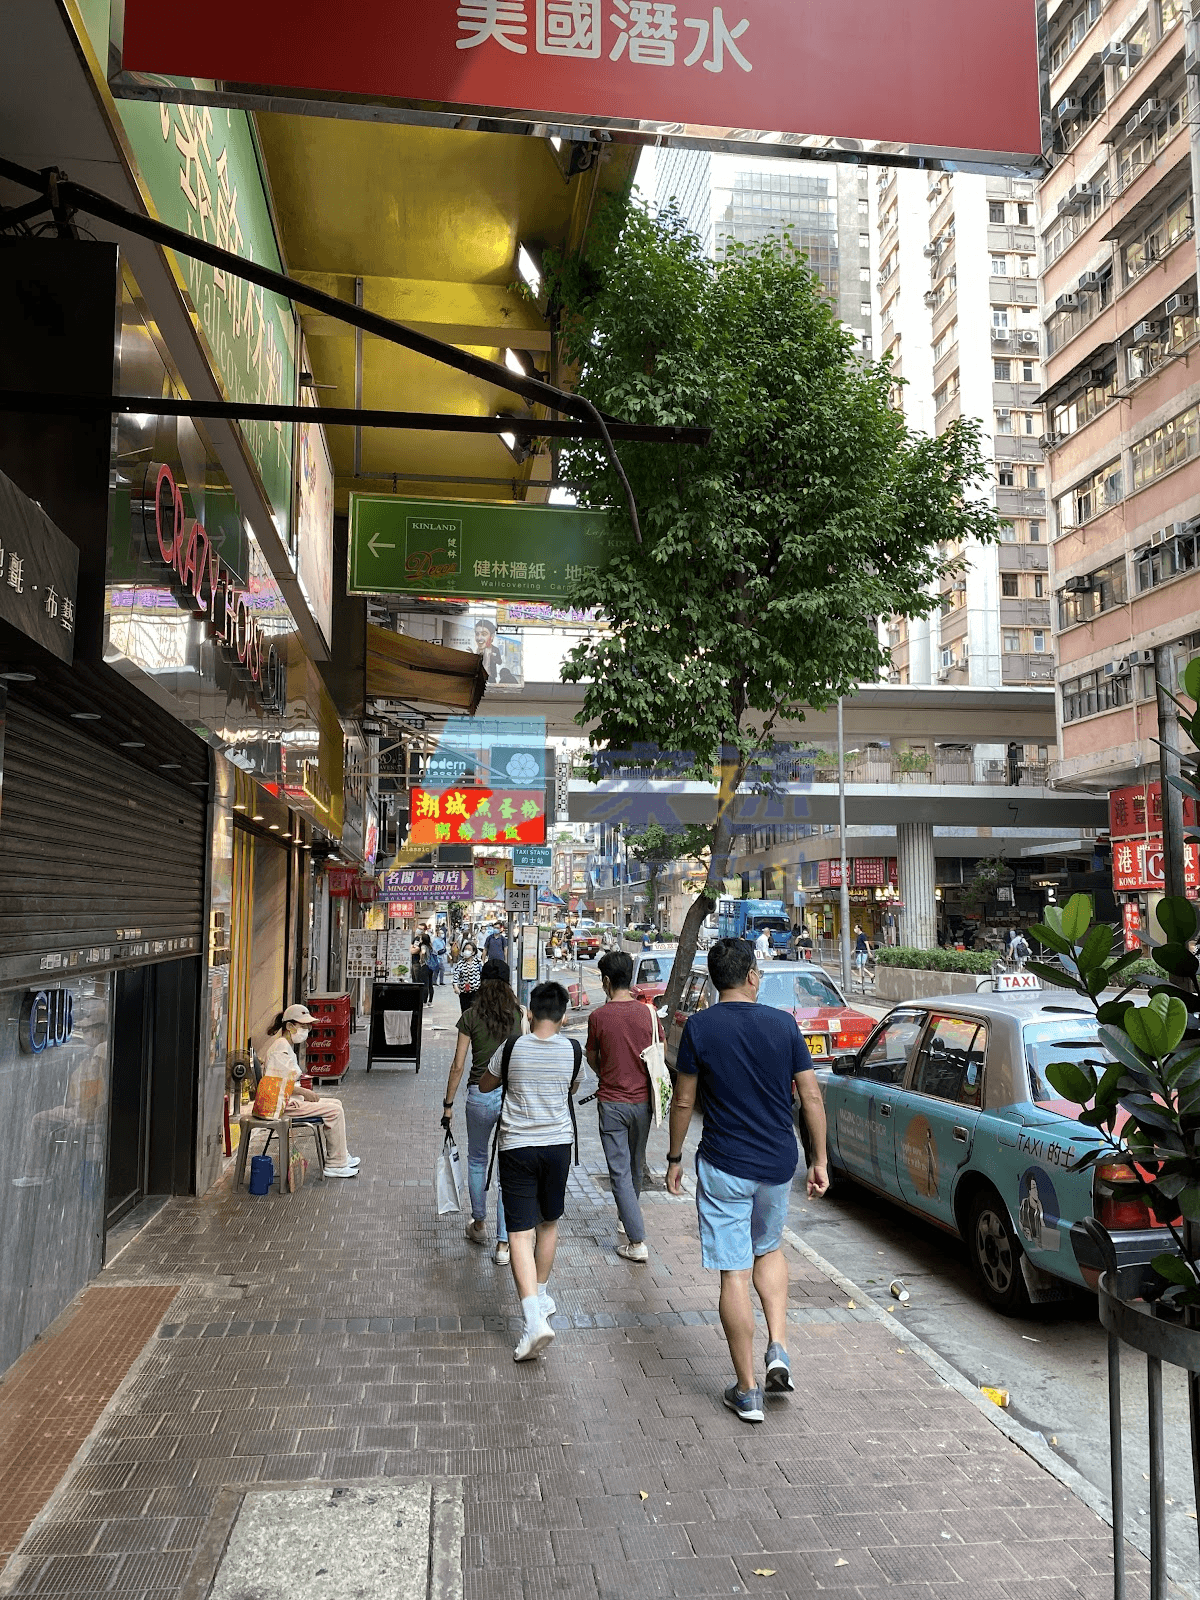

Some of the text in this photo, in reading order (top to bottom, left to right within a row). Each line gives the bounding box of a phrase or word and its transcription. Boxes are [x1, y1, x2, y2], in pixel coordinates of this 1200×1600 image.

[456, 0, 752, 73] 美國潛水
[412, 522, 457, 532] KINLAND
[447, 537, 458, 559] 健林
[481, 580, 540, 591] Wallcovering
[419, 756, 467, 770] Modern
[521, 857, 544, 865] 的士站
[1119, 877, 1137, 886] KONG
[408, 884, 434, 892] COURT
[511, 900, 530, 909] 全日
[1003, 976, 1036, 988] TAXI
[29, 988, 74, 1054] CLUB
[1018, 1134, 1076, 1168] TAXI 的士
